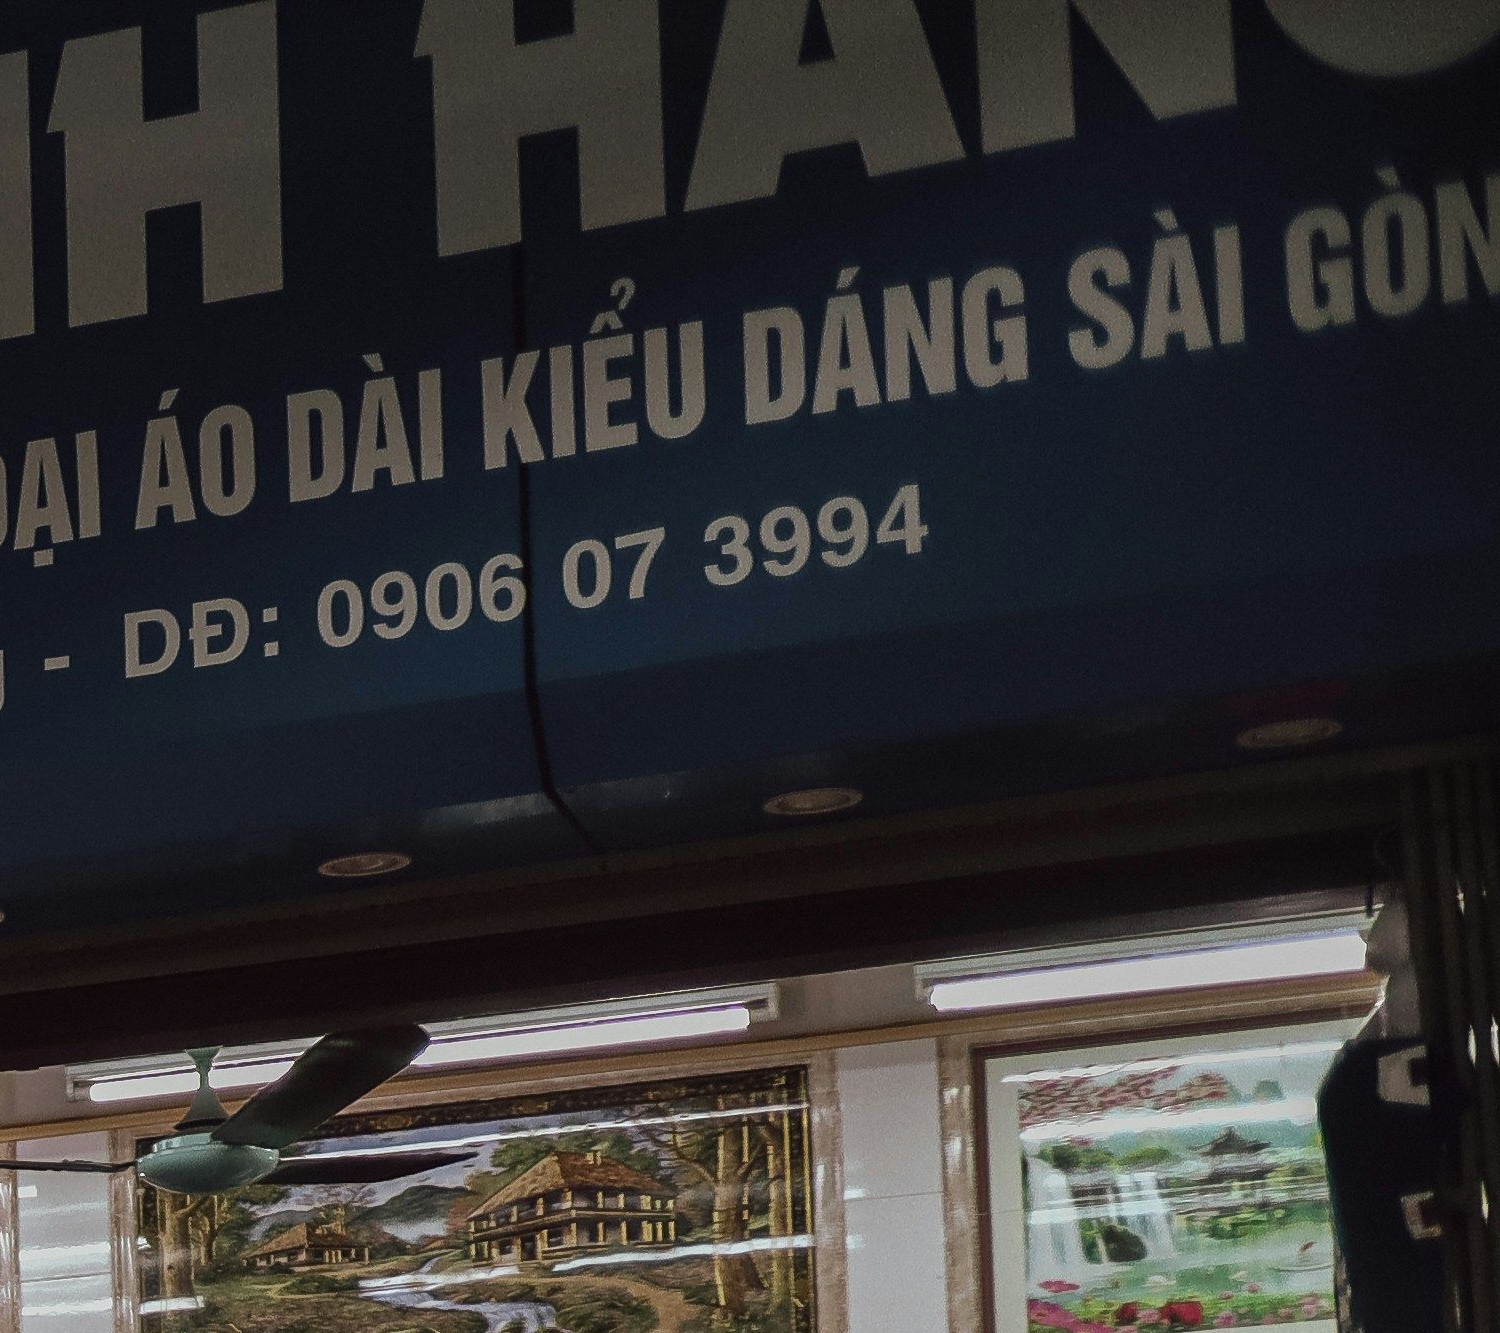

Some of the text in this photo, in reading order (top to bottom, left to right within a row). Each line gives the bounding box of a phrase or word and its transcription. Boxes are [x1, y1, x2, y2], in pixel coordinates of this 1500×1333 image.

[132, 388, 256, 533] ÁO
[286, 352, 445, 501] DÀI
[480, 276, 706, 472] KIỂU
[741, 265, 1031, 428] DÁNG
[1066, 208, 1246, 374] SÀI
[1283, 165, 1500, 333] GÒN
[122, 595, 283, 681] DĐ:
[315, 550, 529, 650] 0906
[561, 526, 669, 611] 07
[702, 481, 929, 589] 3994
